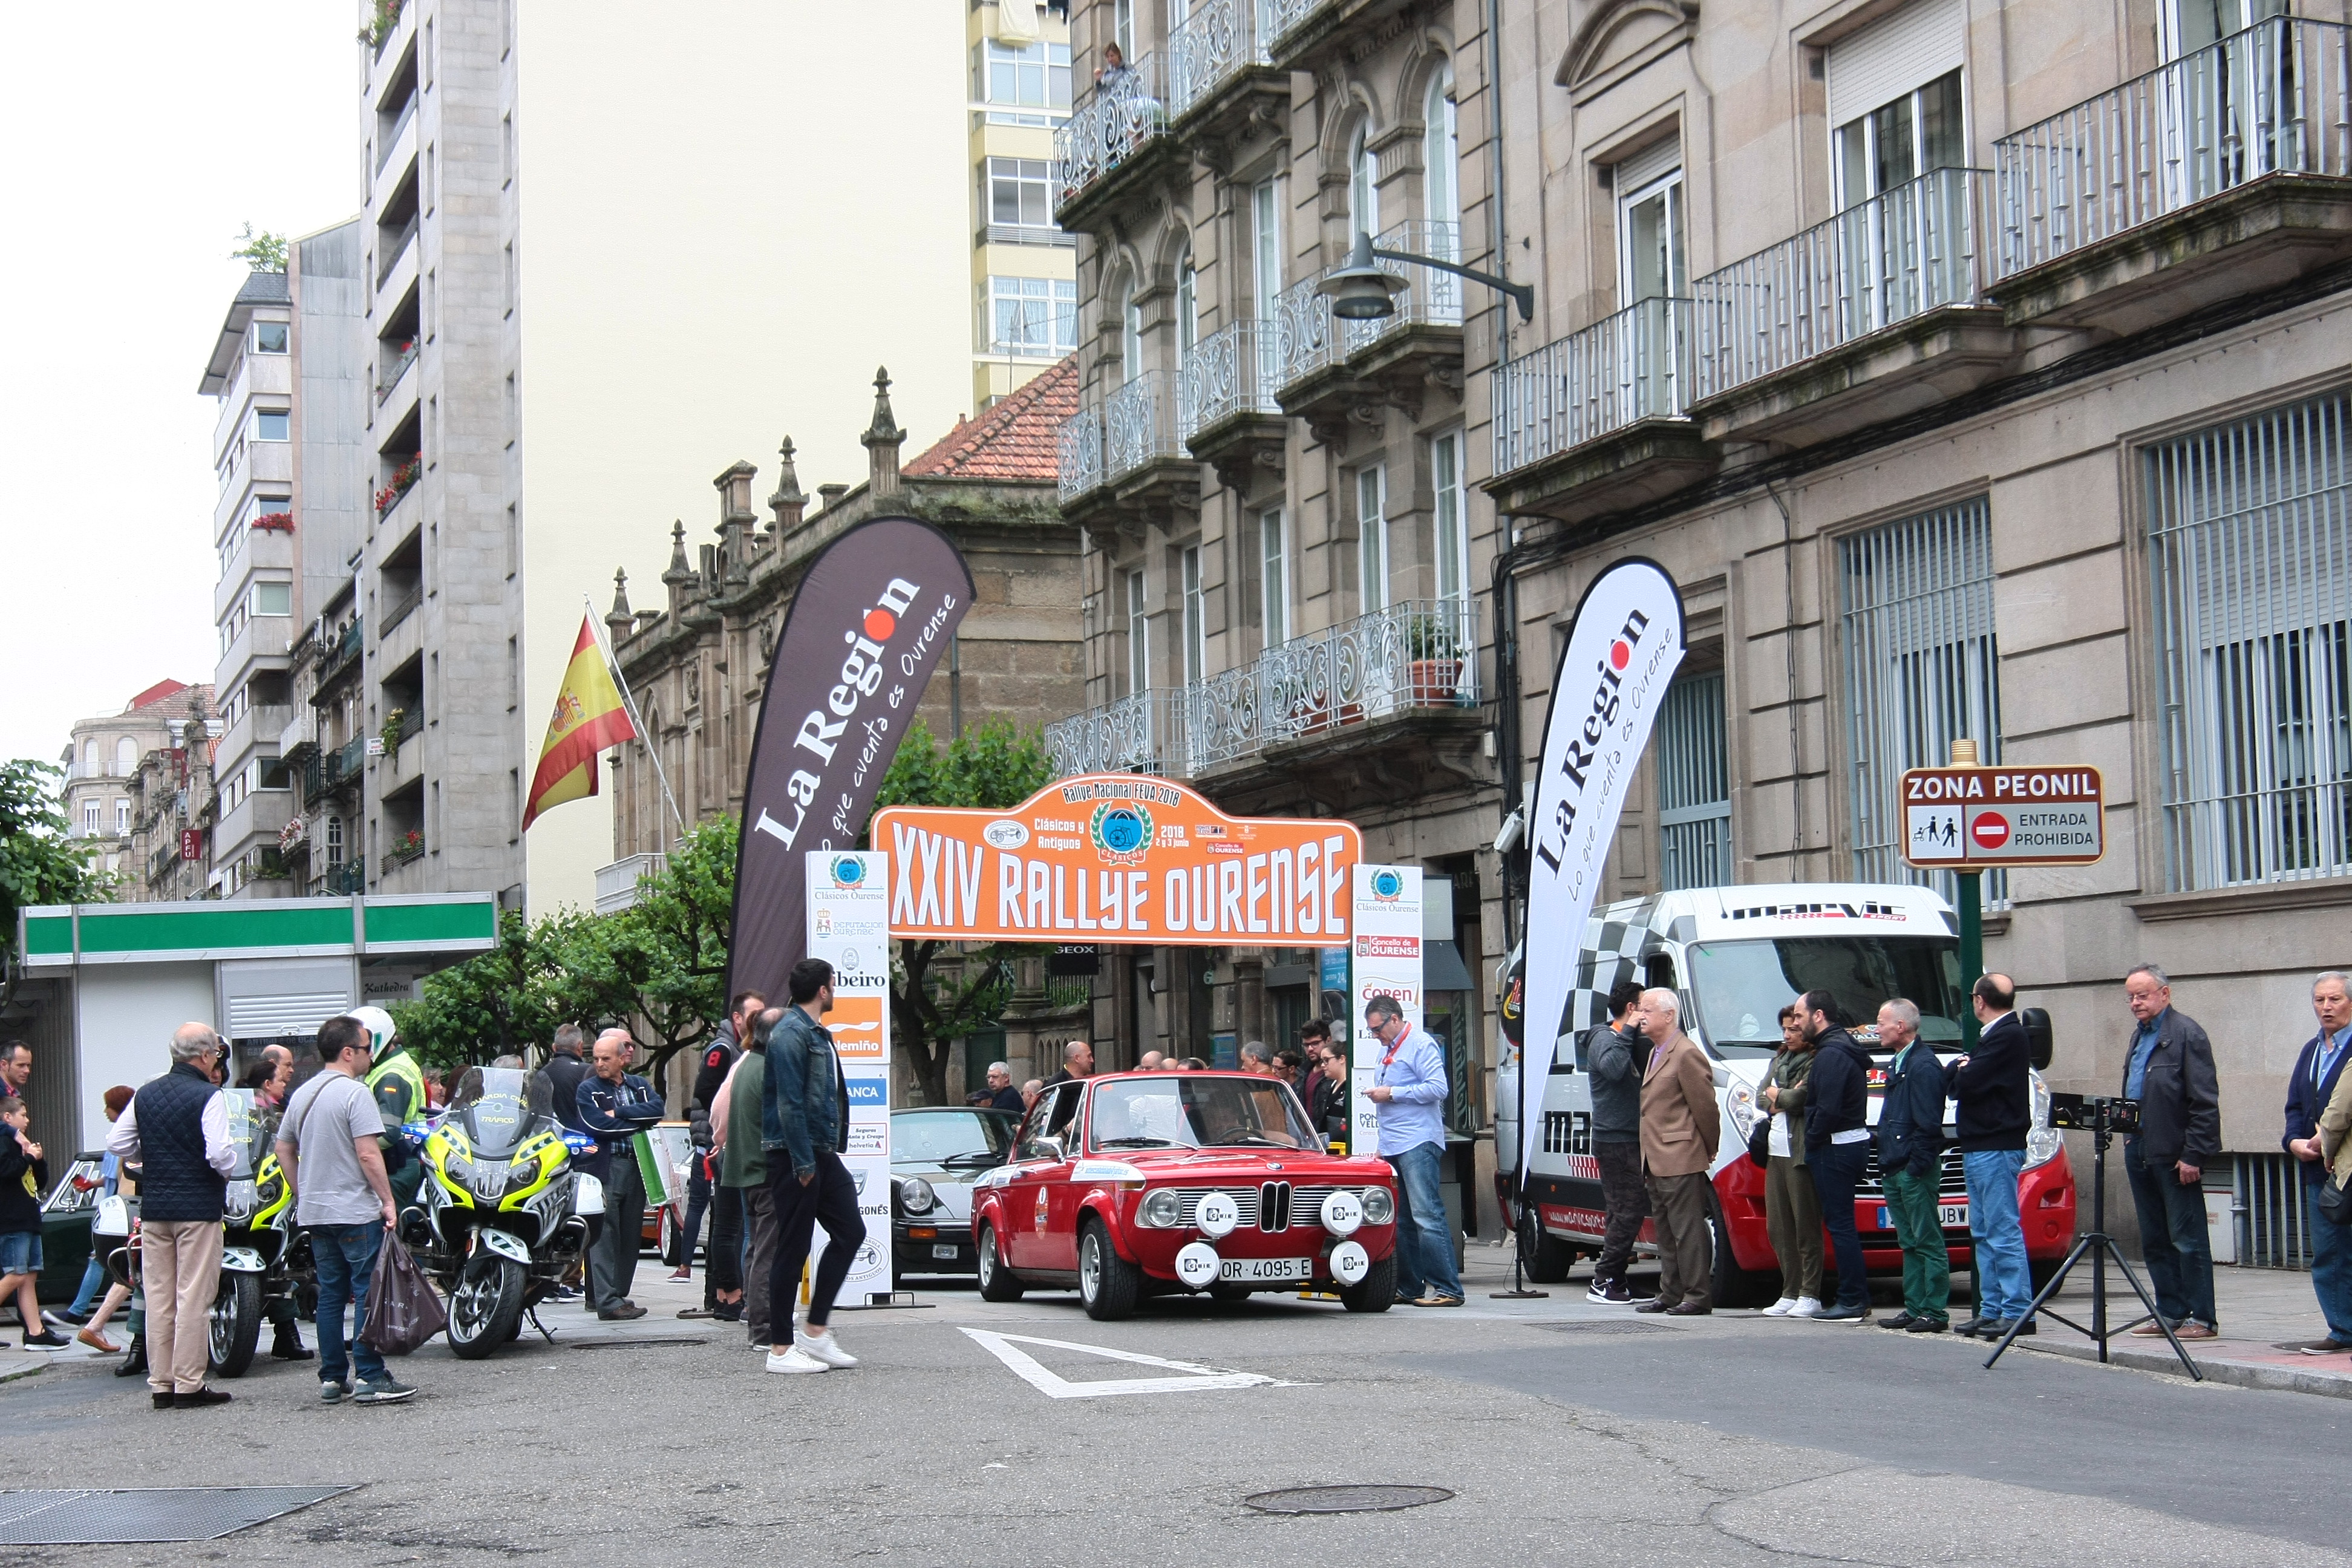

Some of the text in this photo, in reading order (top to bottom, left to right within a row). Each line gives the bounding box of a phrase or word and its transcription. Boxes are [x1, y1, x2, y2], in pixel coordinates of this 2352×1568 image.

[754, 578, 920, 852] La Región
[832, 793, 853, 837] que
[855, 716, 887, 788] cuenta
[889, 685, 904, 709] es
[901, 593, 956, 676] Ourense
[1535, 608, 1650, 880] La Región
[1567, 627, 1673, 902] Lo que cuenta es Ourense
[1062, 782, 1180, 806] Rallye Nacional FEVA 2018
[1907, 774, 2096, 800] ZONA PEONIL
[1034, 818, 1085, 834] Clásicos y
[2019, 813, 2087, 826] ENTRADA
[1161, 825, 1184, 838] 2018
[1038, 835, 1081, 851] Antiguos
[1161, 839, 1166, 848] y
[1174, 838, 1189, 848] junio
[2015, 833, 2093, 846] PROHIBIDA
[1101, 849, 1143, 861] CLASICOS
[892, 821, 1345, 935] XXIV RALLYE OURENSE
[815, 891, 849, 900] Clásicos
[1356, 903, 1387, 912] Clásicos
[1733, 901, 1906, 920] marvic
[1371, 937, 1402, 947] Concello
[1371, 946, 1418, 955] OURENSE
[833, 971, 886, 987] ibeiro
[364, 981, 409, 995] Kathedra
[847, 1087, 878, 1097] ANCA
[470, 1093, 528, 1108] GUARDIA CIVIL
[859, 1203, 889, 1216] GONÉS
[855, 1267, 882, 1281] ANTIGUOS
